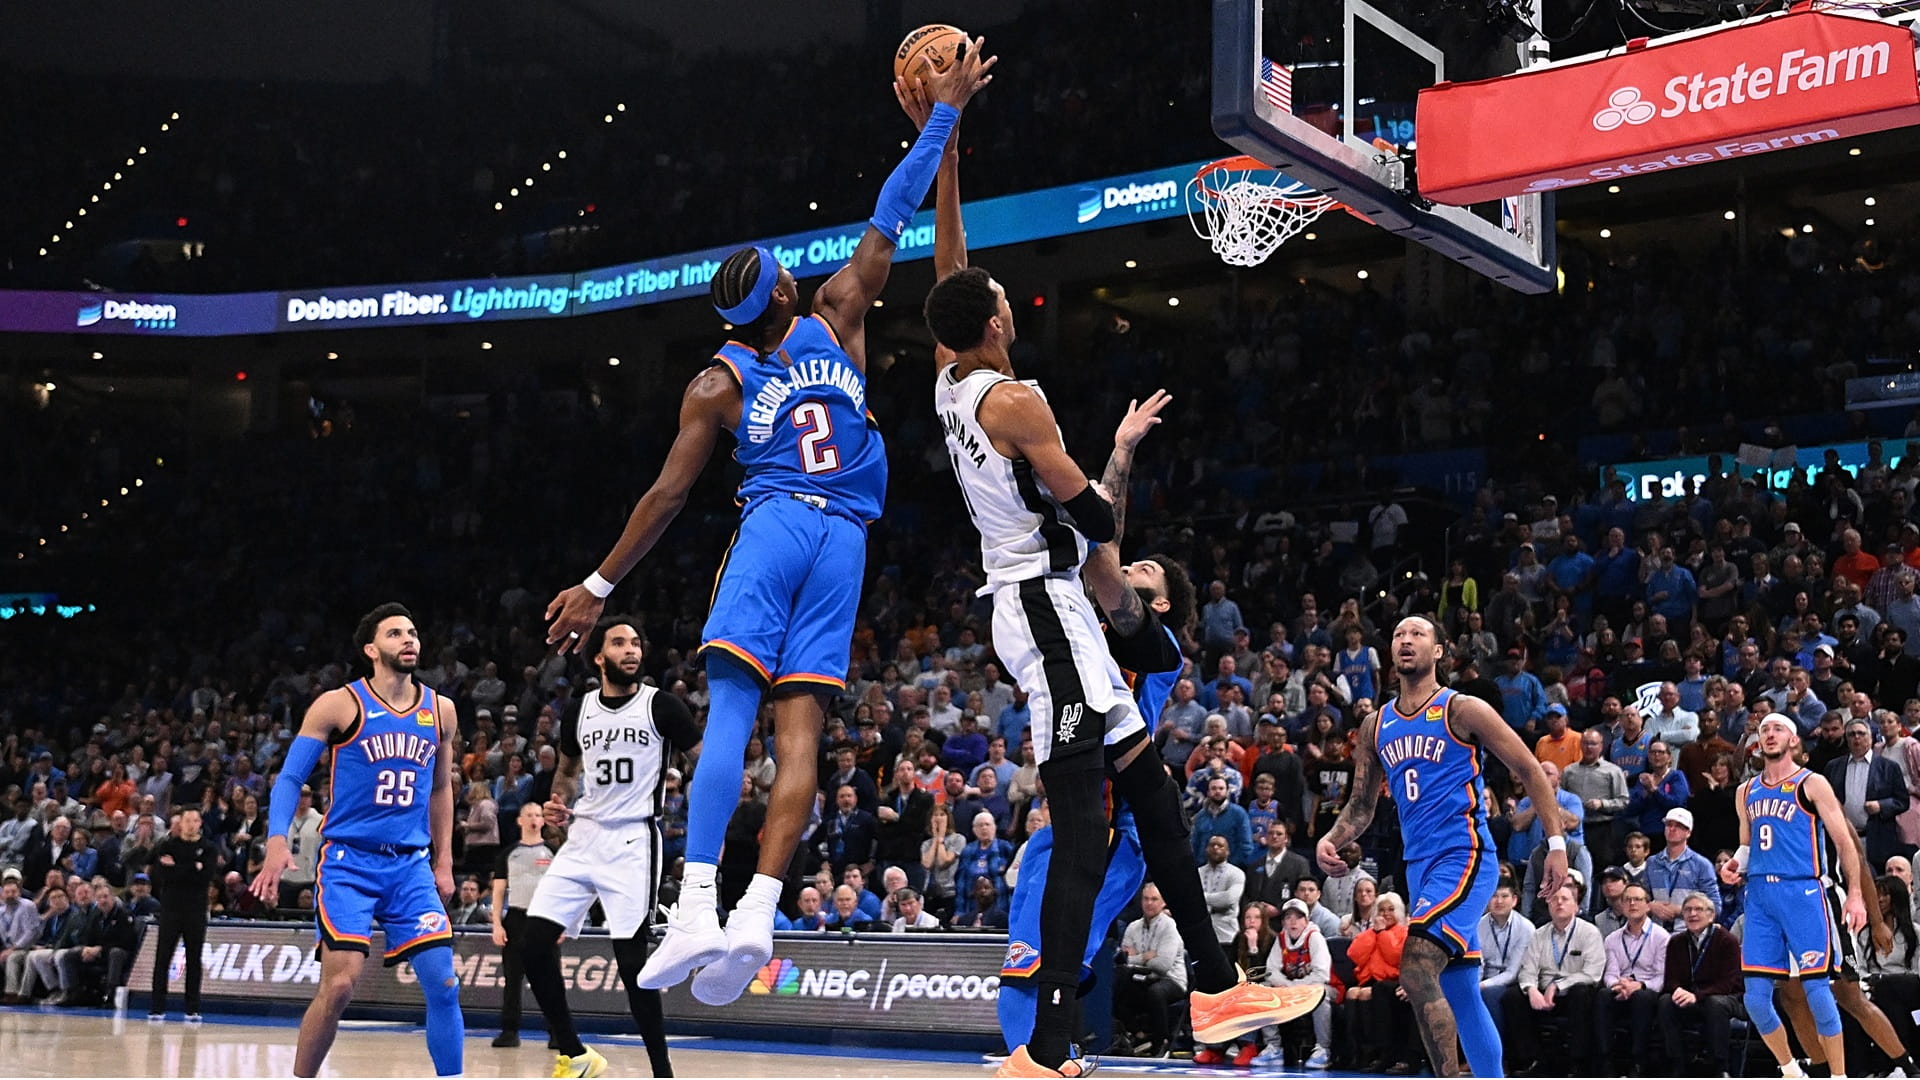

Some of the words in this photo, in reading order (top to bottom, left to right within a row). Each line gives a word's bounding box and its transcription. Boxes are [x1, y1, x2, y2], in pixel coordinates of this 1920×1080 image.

[1104, 180, 1178, 209] Dobson
[104, 299, 177, 321] Dobson
[287, 296, 379, 322] Dobson
[381, 290, 449, 317] Fiber.
[626, 268, 680, 296] Fiber
[791, 398, 841, 475] 2
[359, 732, 438, 769] THUNDER
[1380, 733, 1447, 770] THUNDER
[374, 768, 418, 808] 25
[595, 757, 634, 785] 30
[1403, 767, 1421, 802] 6
[1747, 798, 1797, 823] HUNDER
[1758, 823, 1774, 852] 9
[200, 942, 275, 983] MLK
[270, 945, 322, 984] DA
[800, 968, 872, 999] NBC
[882, 973, 1001, 1012] peacoc
